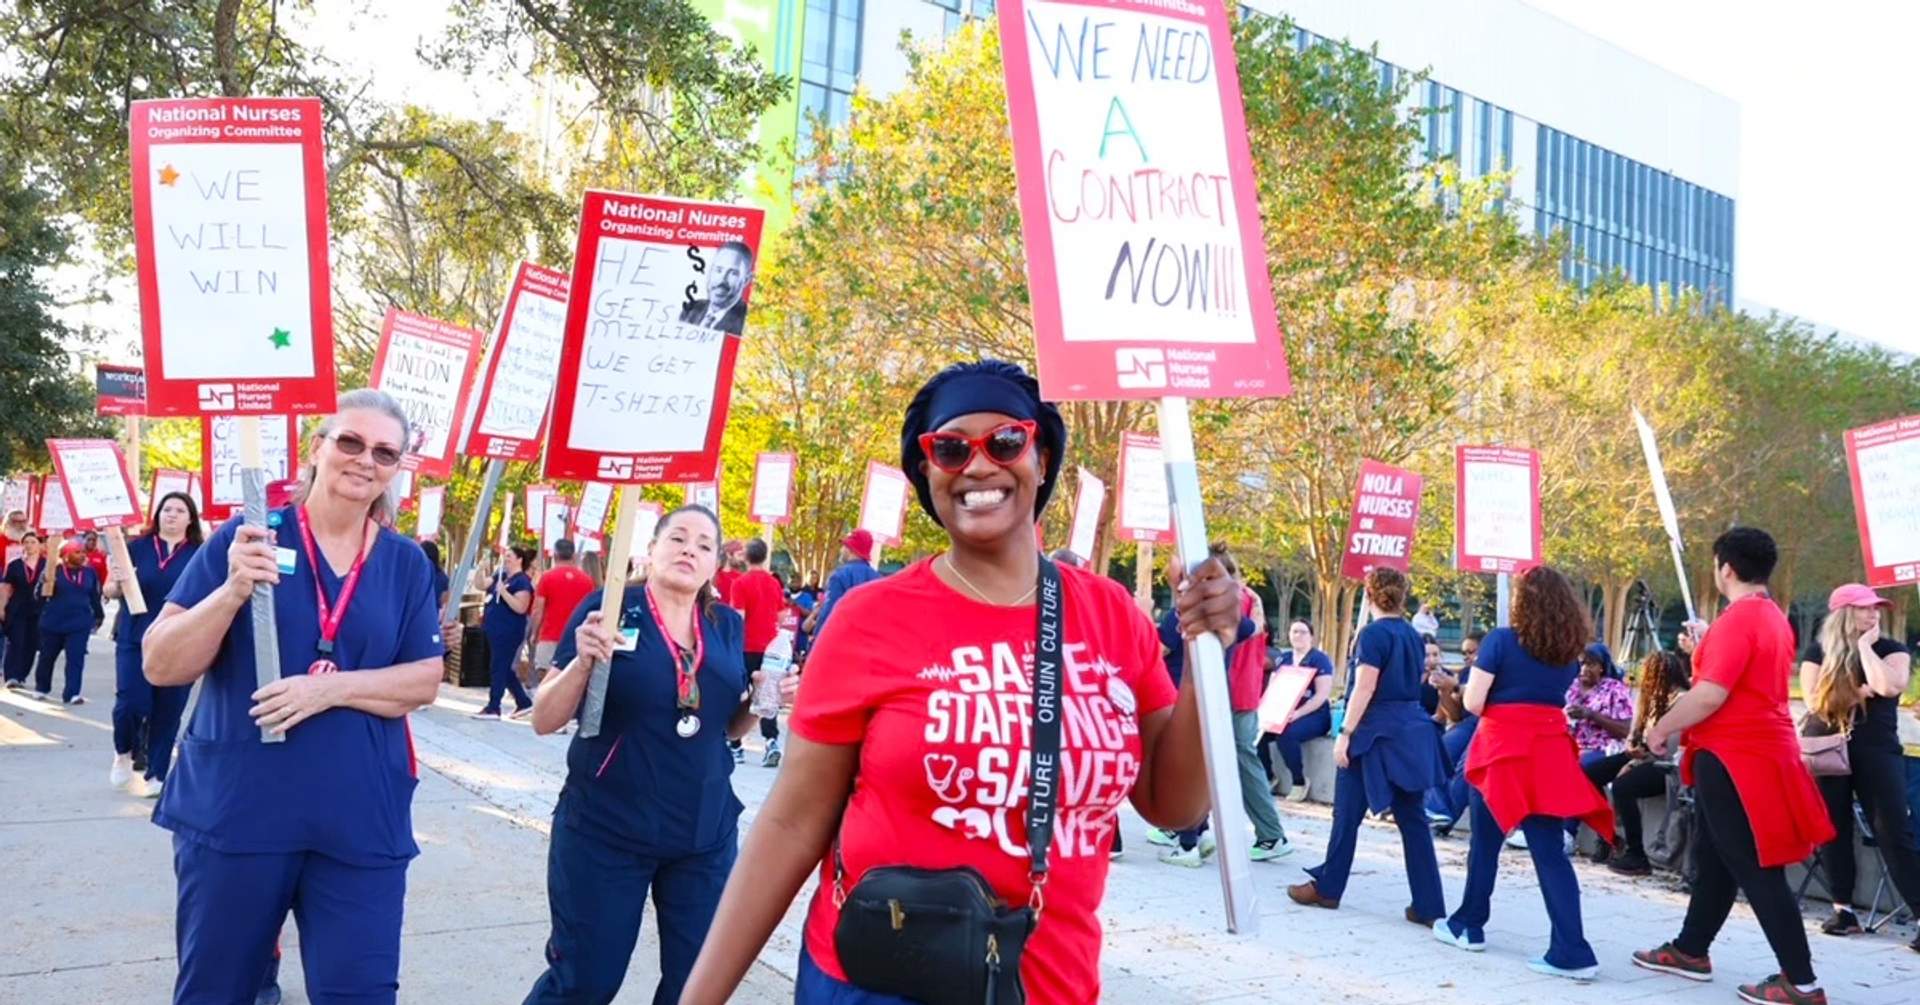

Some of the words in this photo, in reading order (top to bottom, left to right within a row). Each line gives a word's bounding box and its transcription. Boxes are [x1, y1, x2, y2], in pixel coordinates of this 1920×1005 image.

[1027, 9, 1116, 83] WE
[1131, 22, 1211, 84] NEED
[148, 105, 226, 123] National
[233, 105, 302, 122] Nurses
[148, 125, 221, 139] Organizing
[224, 124, 302, 137] Committee
[1099, 95, 1149, 163] A
[190, 169, 262, 201] WE
[1048, 148, 1228, 227] CONTRACT
[603, 200, 684, 224] National
[689, 209, 747, 229] Nurses
[168, 222, 288, 250] WILL
[600, 219, 674, 239] Organizing
[677, 228, 744, 243] Committee
[598, 241, 671, 287] HE
[1104, 237, 1238, 318] NOW!!!
[189, 269, 277, 295] WIN
[594, 288, 676, 324] GETS
[389, 350, 451, 383] UNION
[586, 345, 631, 374] WE
[647, 353, 697, 375] GET
[1167, 348, 1216, 362] National
[1169, 363, 1209, 374] Nurses
[236, 382, 280, 392] National
[1170, 375, 1211, 389] United
[237, 393, 273, 401] Nurses
[238, 401, 273, 410] United
[582, 382, 707, 418] T-SHIRTS
[635, 455, 674, 465] National
[1361, 474, 1403, 496] NOLA
[1357, 495, 1414, 519] NURSES
[1350, 532, 1408, 557] STRIKE
[1040, 576, 1058, 653] CULTURE
[951, 641, 1100, 693] SAE
[1037, 661, 1057, 723] ORIJIN
[924, 689, 1125, 750] STAFFNG
